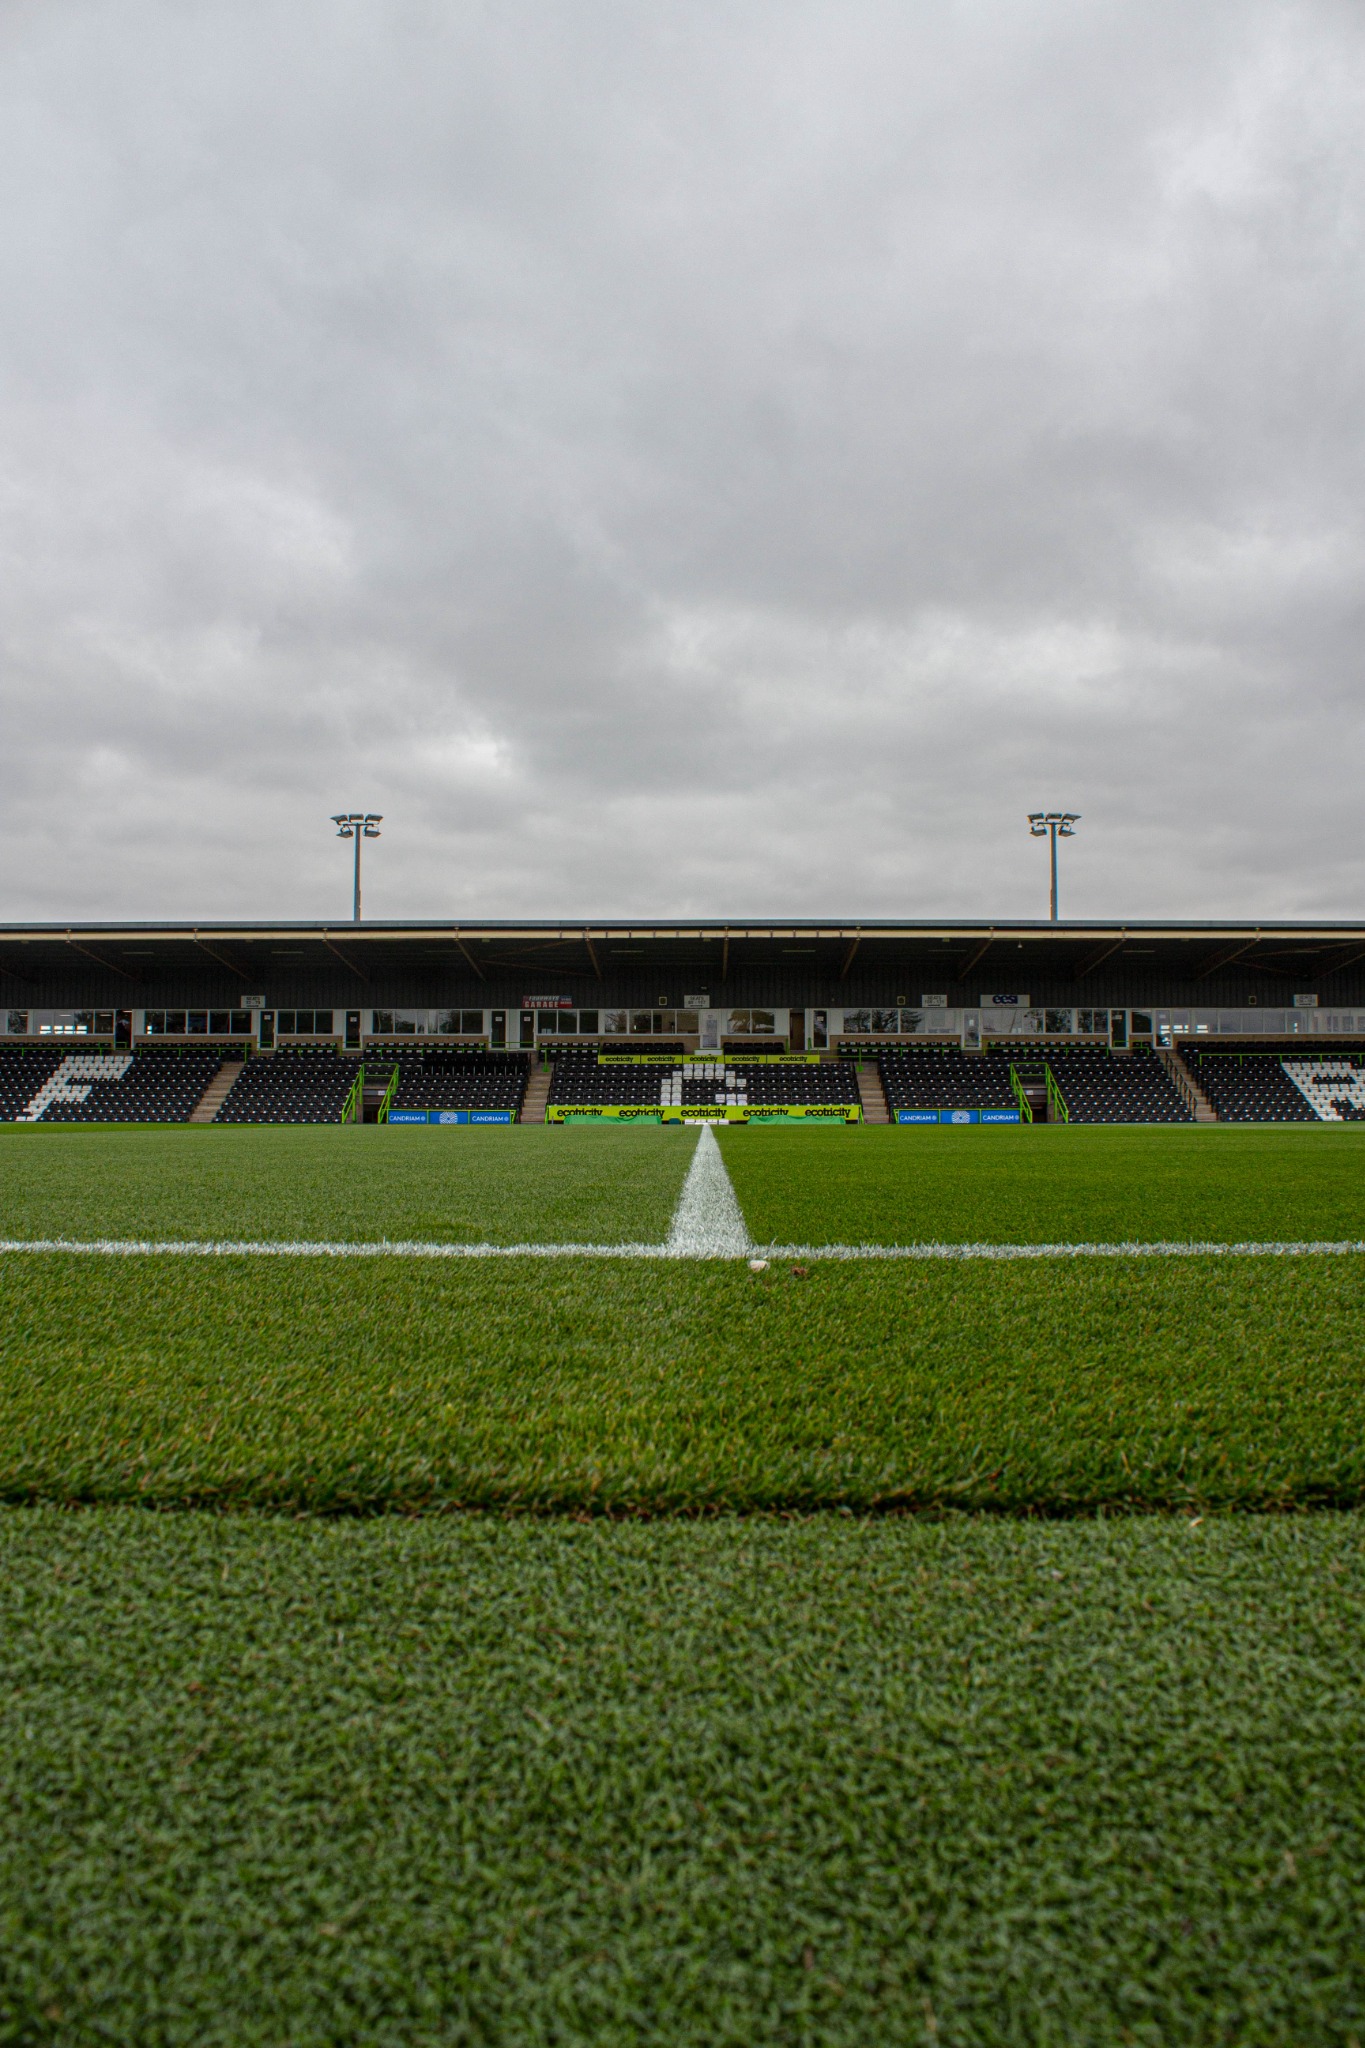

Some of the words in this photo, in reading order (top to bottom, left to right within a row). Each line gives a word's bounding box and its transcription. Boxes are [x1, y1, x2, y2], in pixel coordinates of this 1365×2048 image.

[557, 1108, 603, 1116] ecotricity
[619, 1108, 665, 1118] ecotricity
[681, 1108, 727, 1118] ecotricity
[743, 1108, 789, 1116] ecotricity
[804, 1108, 851, 1118] ecotricity
